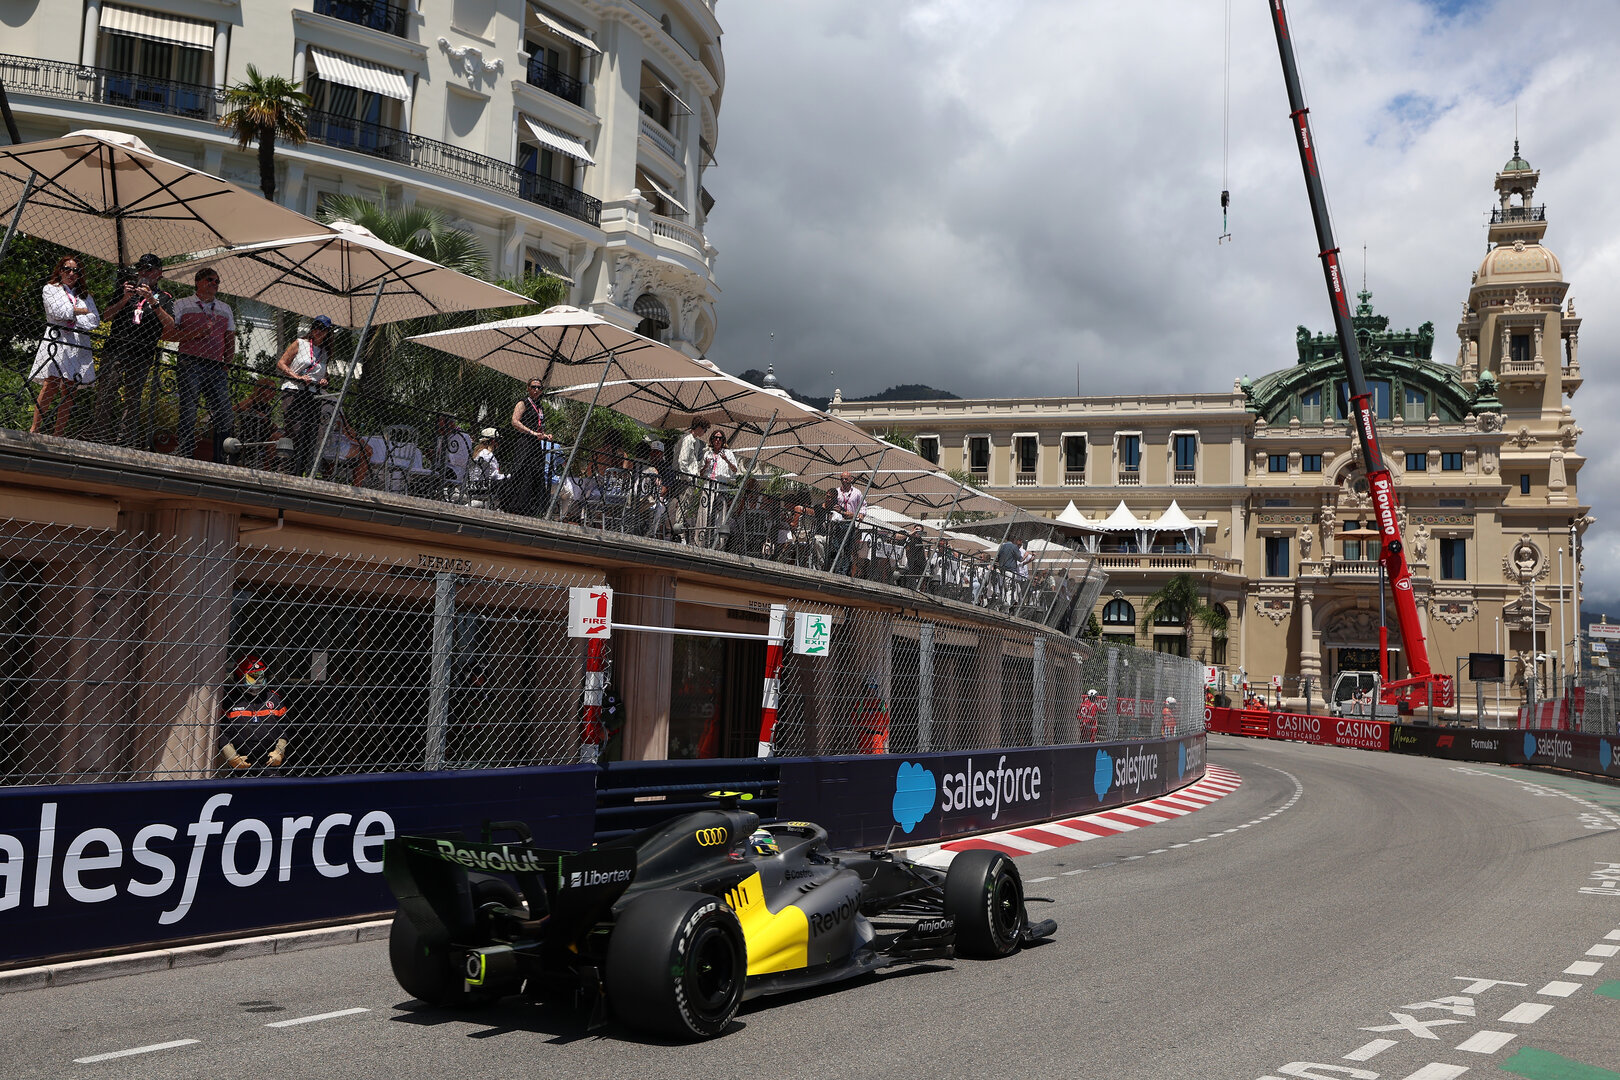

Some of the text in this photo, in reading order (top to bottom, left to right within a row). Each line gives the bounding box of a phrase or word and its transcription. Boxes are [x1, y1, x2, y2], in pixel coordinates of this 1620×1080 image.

[1330, 264, 1341, 293] Piovano
[1361, 408, 1374, 441] Piovano
[1374, 479, 1395, 536] Piovano
[582, 617, 607, 625] FIRE
[1276, 715, 1321, 734] CASINO
[1336, 721, 1382, 740] CASINO
[1471, 738, 1493, 750] Formula
[1537, 732, 1572, 763] salesforce
[1115, 745, 1158, 794] salesforce
[941, 755, 1041, 820] salesforce
[436, 840, 546, 872] Revolut
[584, 868, 631, 886] Libertex
[683, 902, 716, 939] ZERO
[917, 918, 954, 933] ninjaOne
